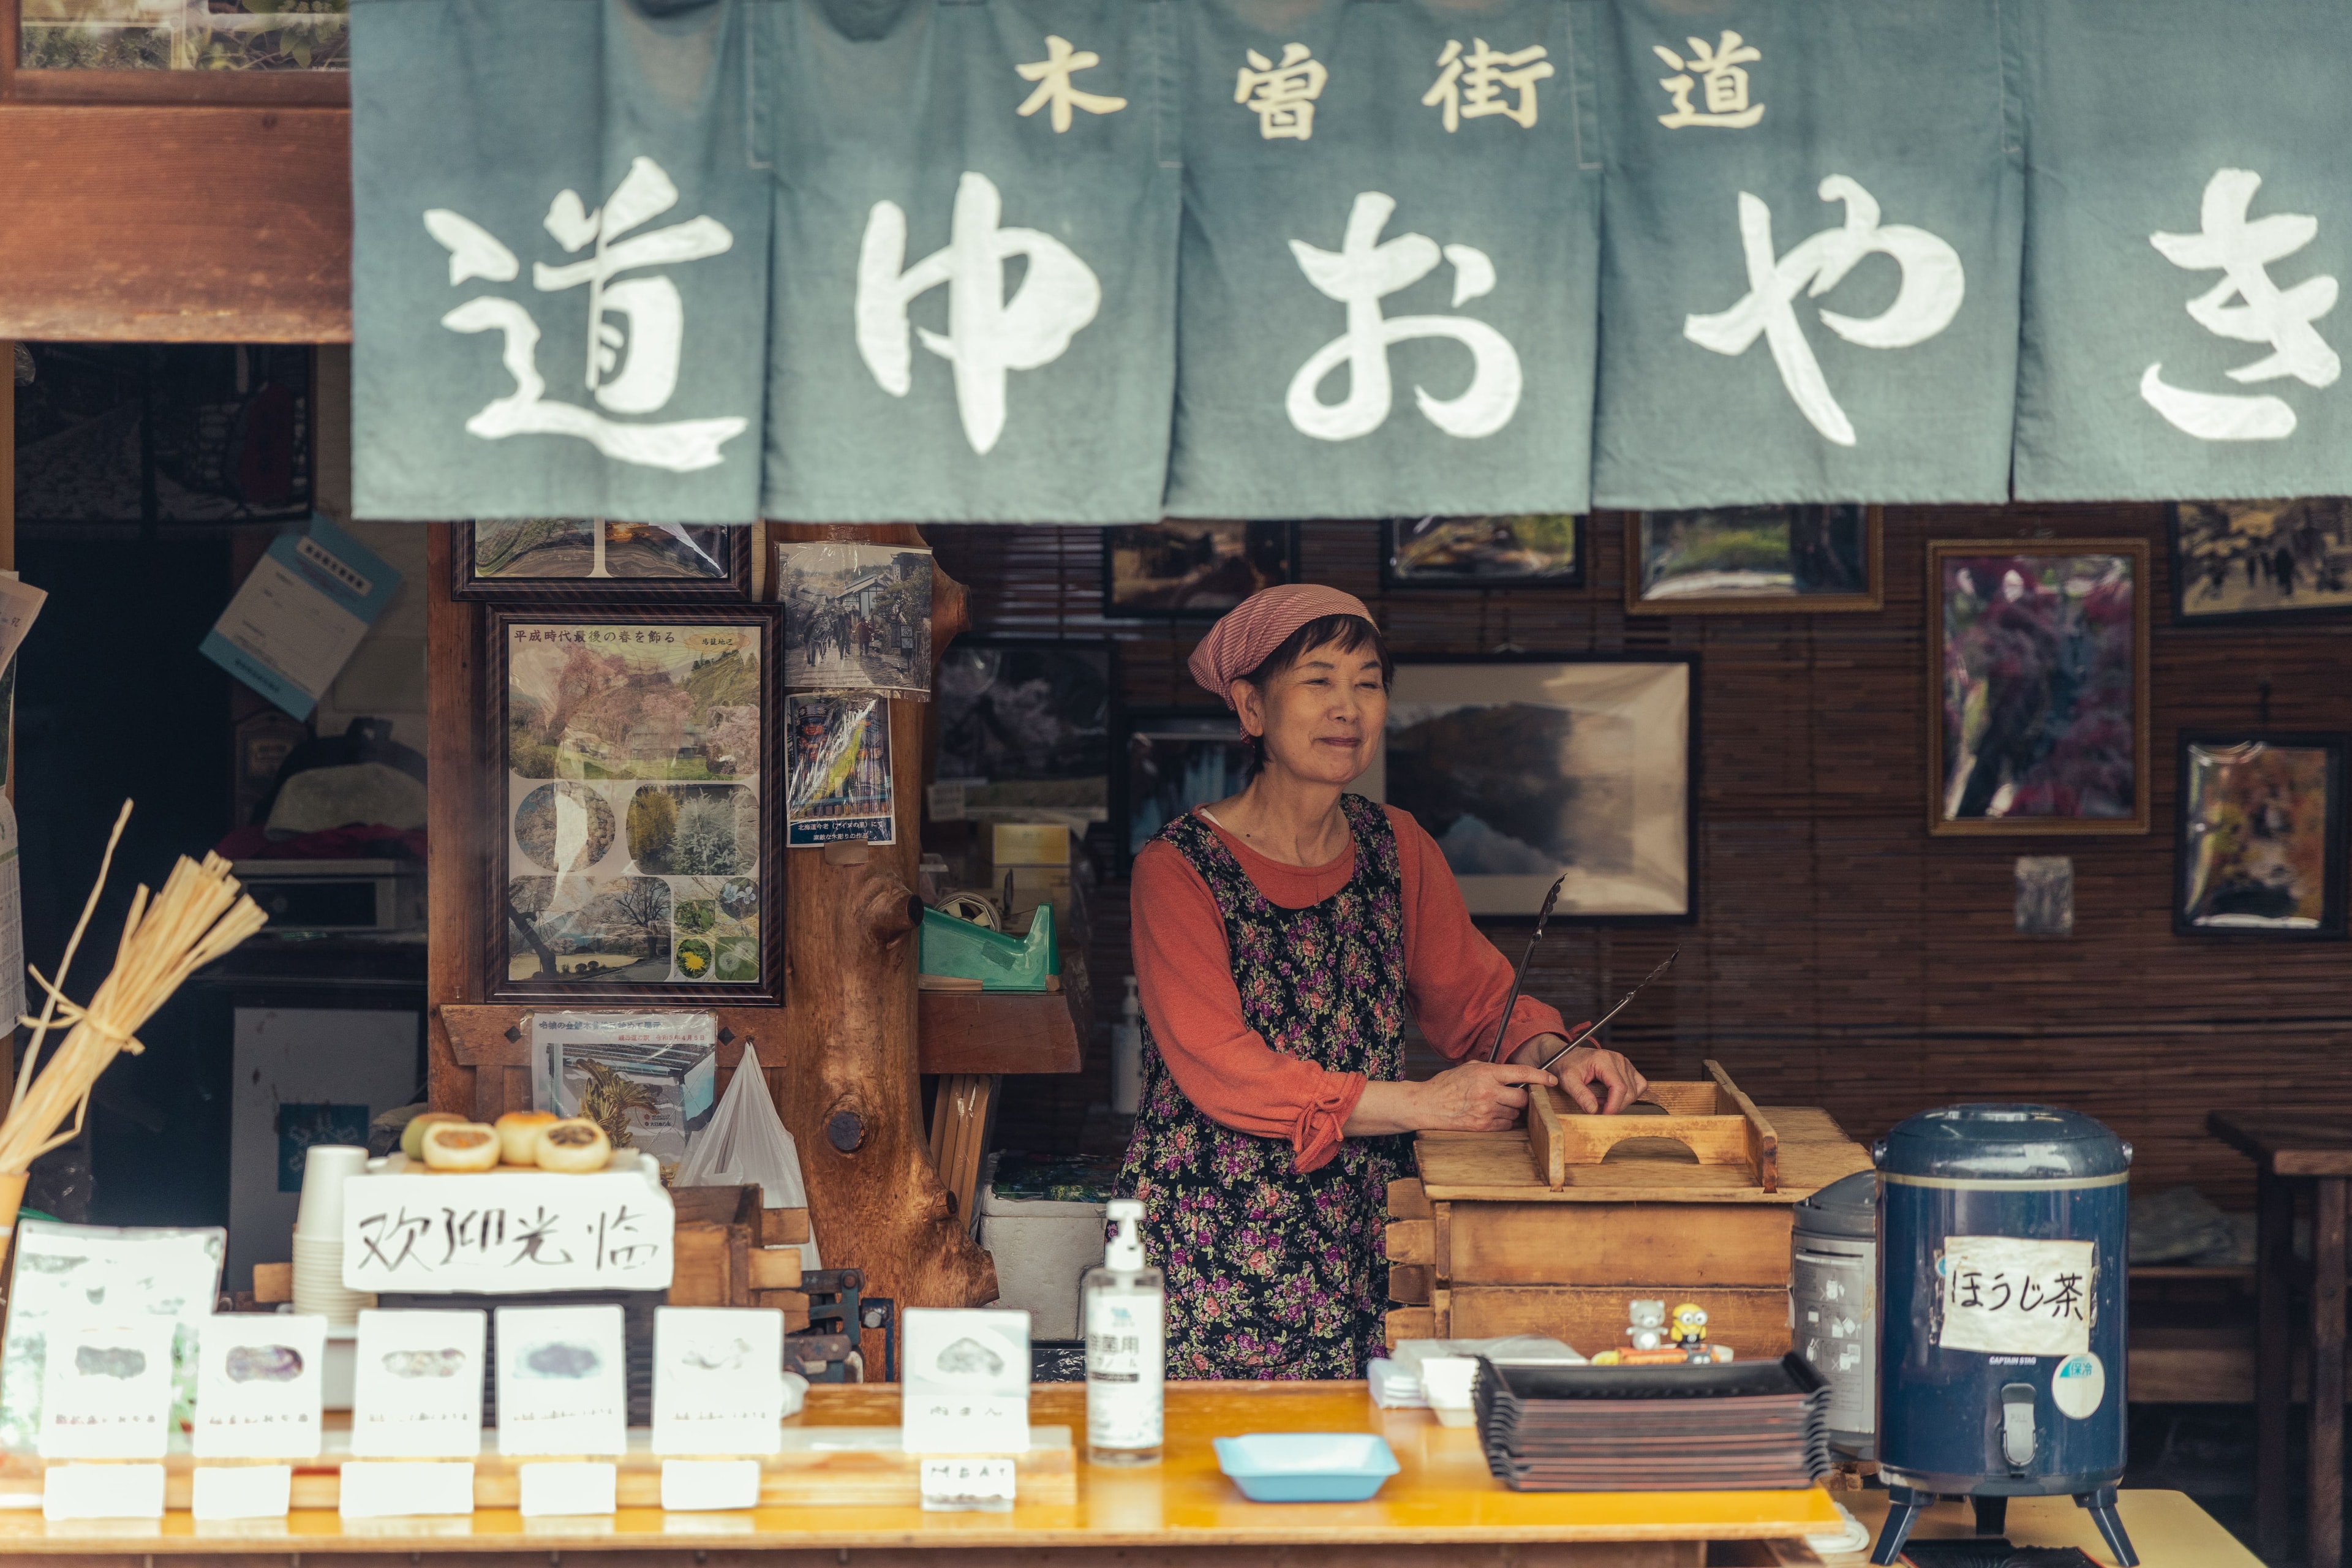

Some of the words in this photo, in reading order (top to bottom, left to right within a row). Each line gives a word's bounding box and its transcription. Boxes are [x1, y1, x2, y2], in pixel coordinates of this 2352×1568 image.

[514, 630, 674, 643] 平成時代最後の春を飾る
[358, 1205, 659, 1272] 欢迎光临
[1952, 1270, 2084, 1321] ほうじ茶
[1989, 1357, 2018, 1365] CAPTAIN
[2019, 1357, 2037, 1366] STAG
[2071, 1362, 2092, 1376] 保冷
